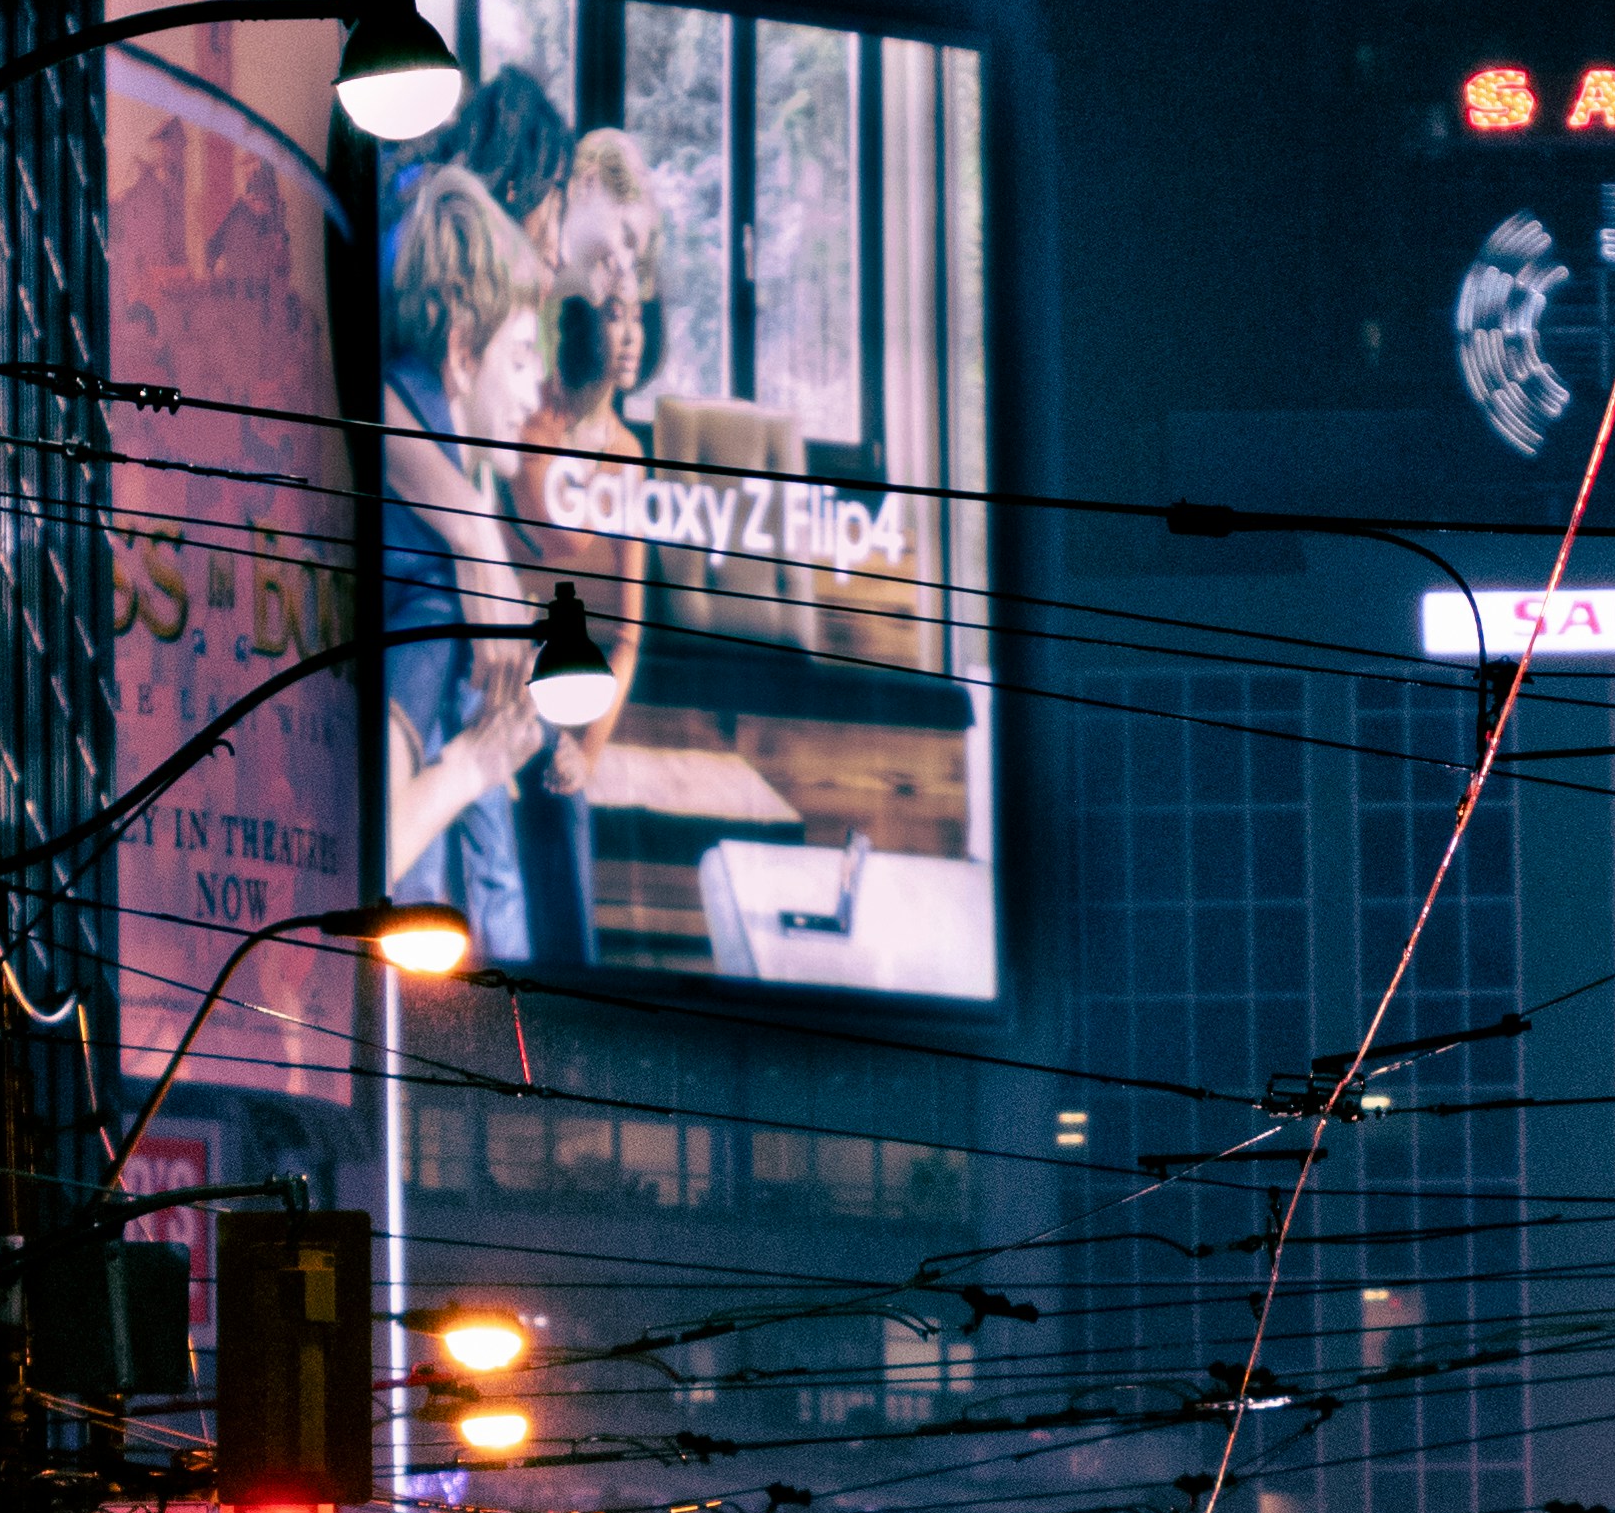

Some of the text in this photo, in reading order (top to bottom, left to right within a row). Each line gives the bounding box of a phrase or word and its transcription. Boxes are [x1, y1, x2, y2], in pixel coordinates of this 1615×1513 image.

[544, 456, 906, 586] Galaxy Z Flip4
[174, 808, 209, 851] IN
[196, 871, 268, 923] NOW
